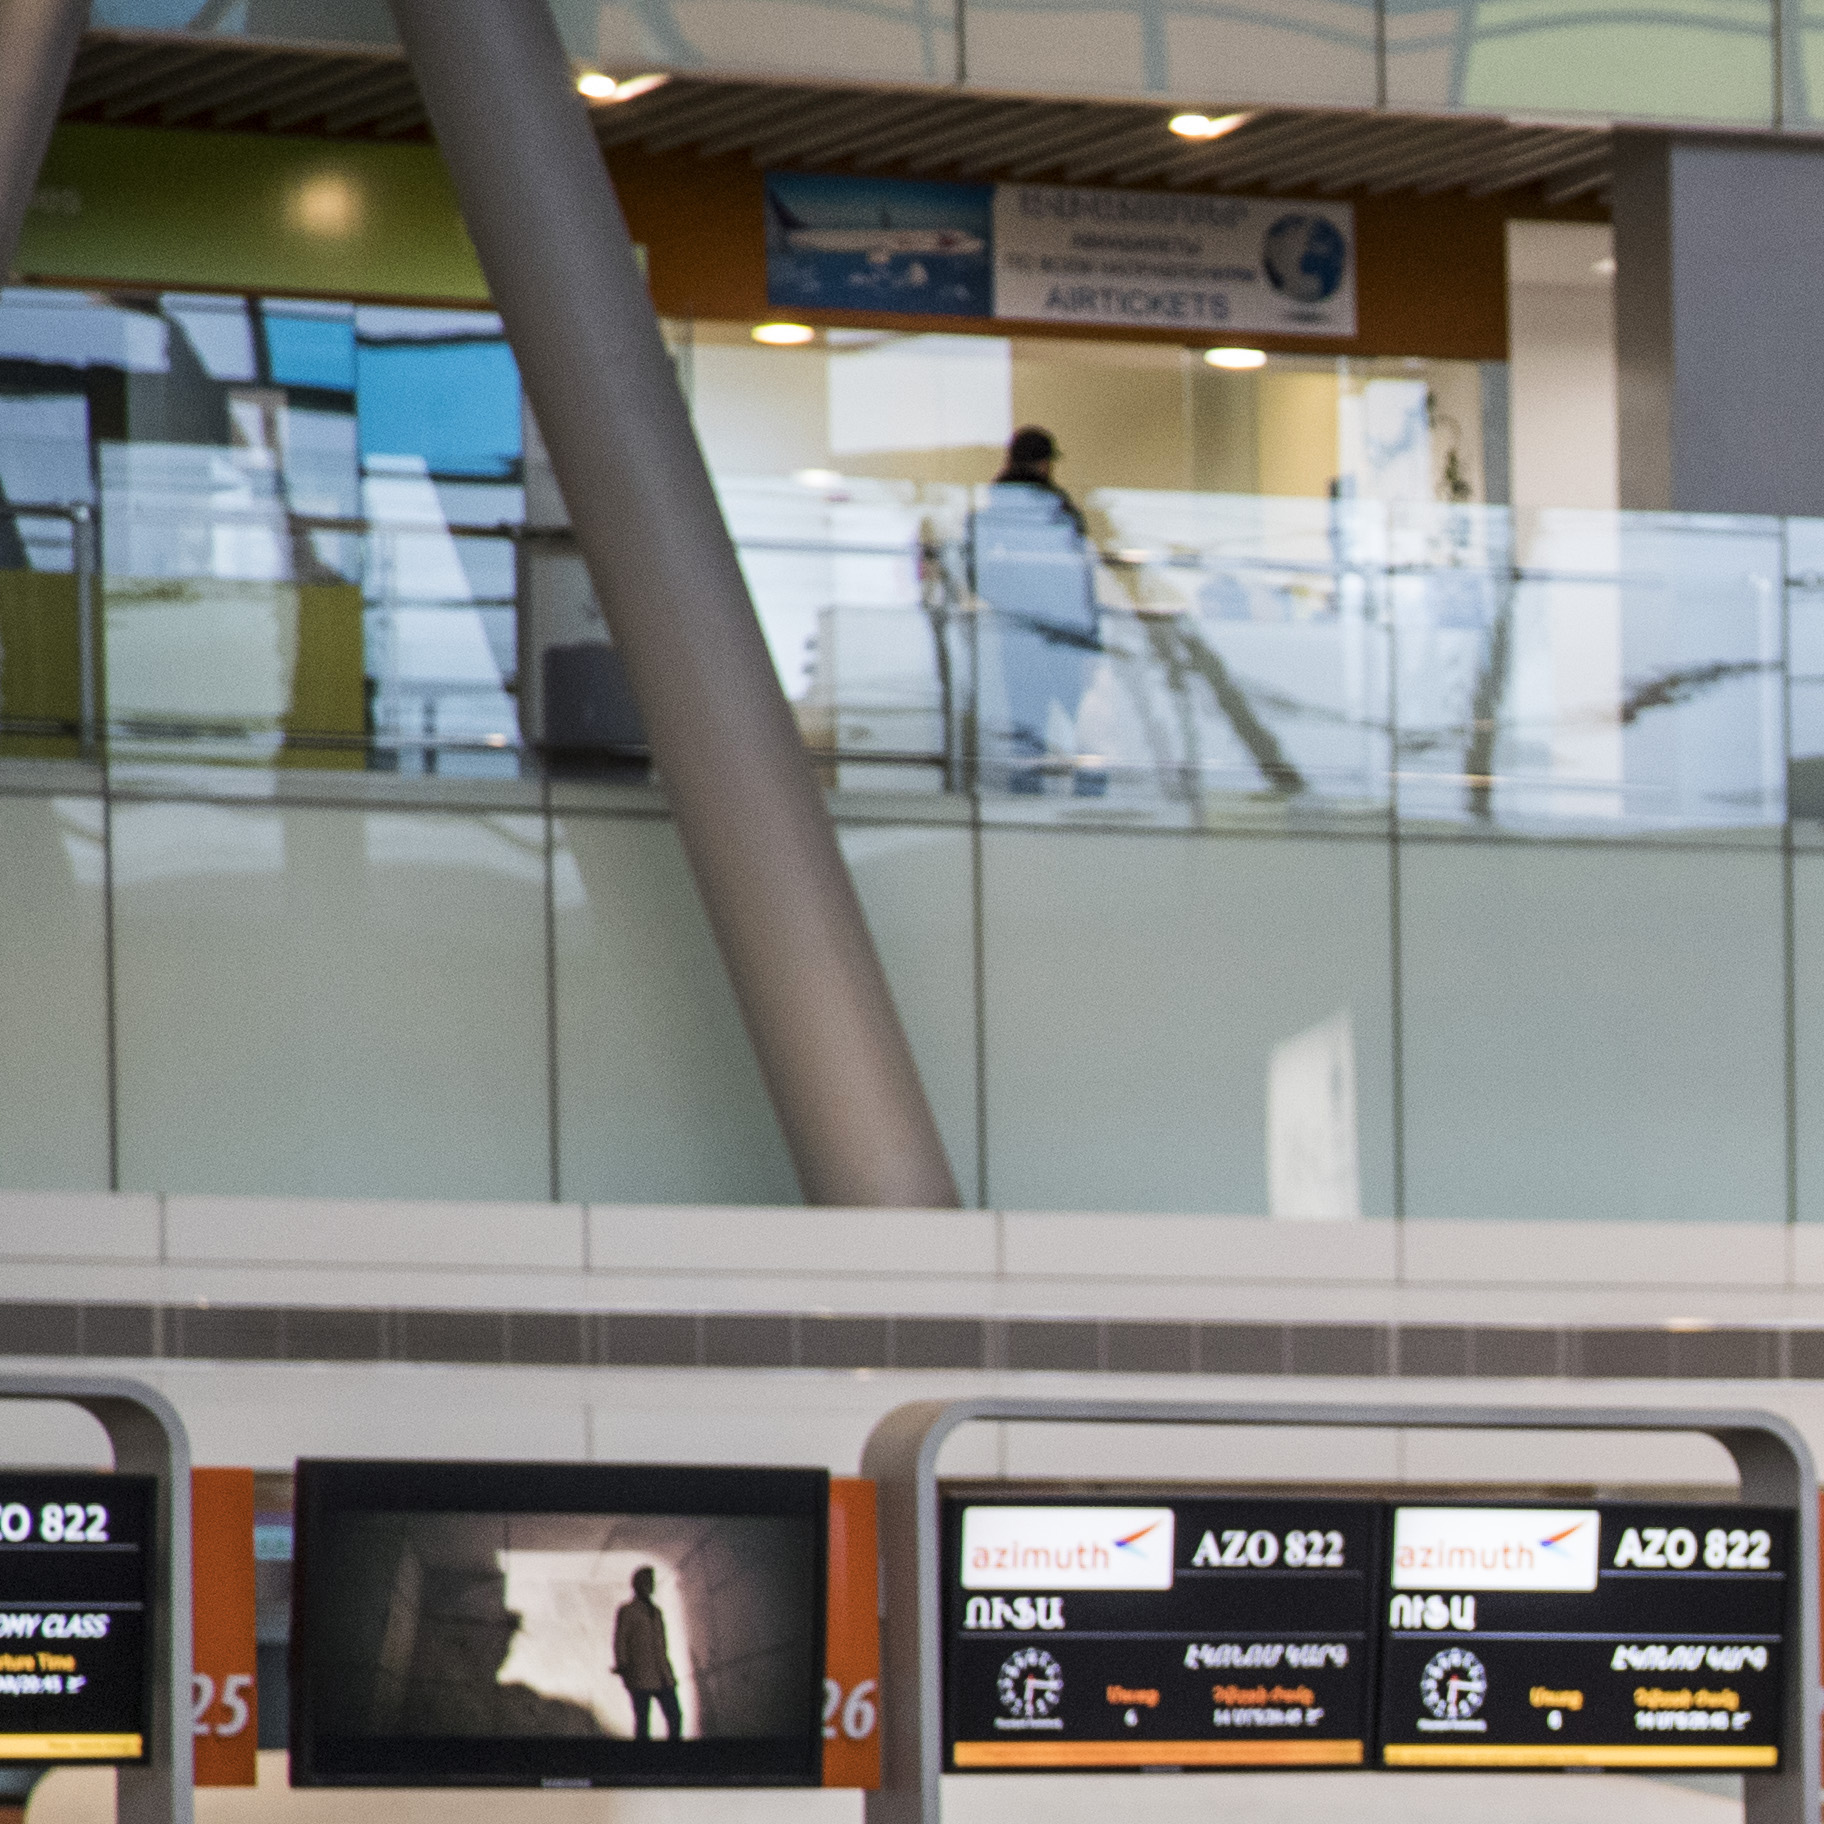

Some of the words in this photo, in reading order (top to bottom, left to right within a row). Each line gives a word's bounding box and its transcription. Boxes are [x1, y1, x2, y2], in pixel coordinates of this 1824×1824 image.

[40, 1503, 109, 1543] 822
[971, 1541, 1110, 1570] azimuth
[1192, 1530, 1279, 1567] AZO
[1283, 1530, 1345, 1567] 822
[1396, 1541, 1535, 1570] azimuth
[1614, 1527, 1697, 1569] AZO
[1702, 1528, 1772, 1570] 822
[42, 1614, 110, 1638] CLASS
[193, 1673, 254, 1737] 25
